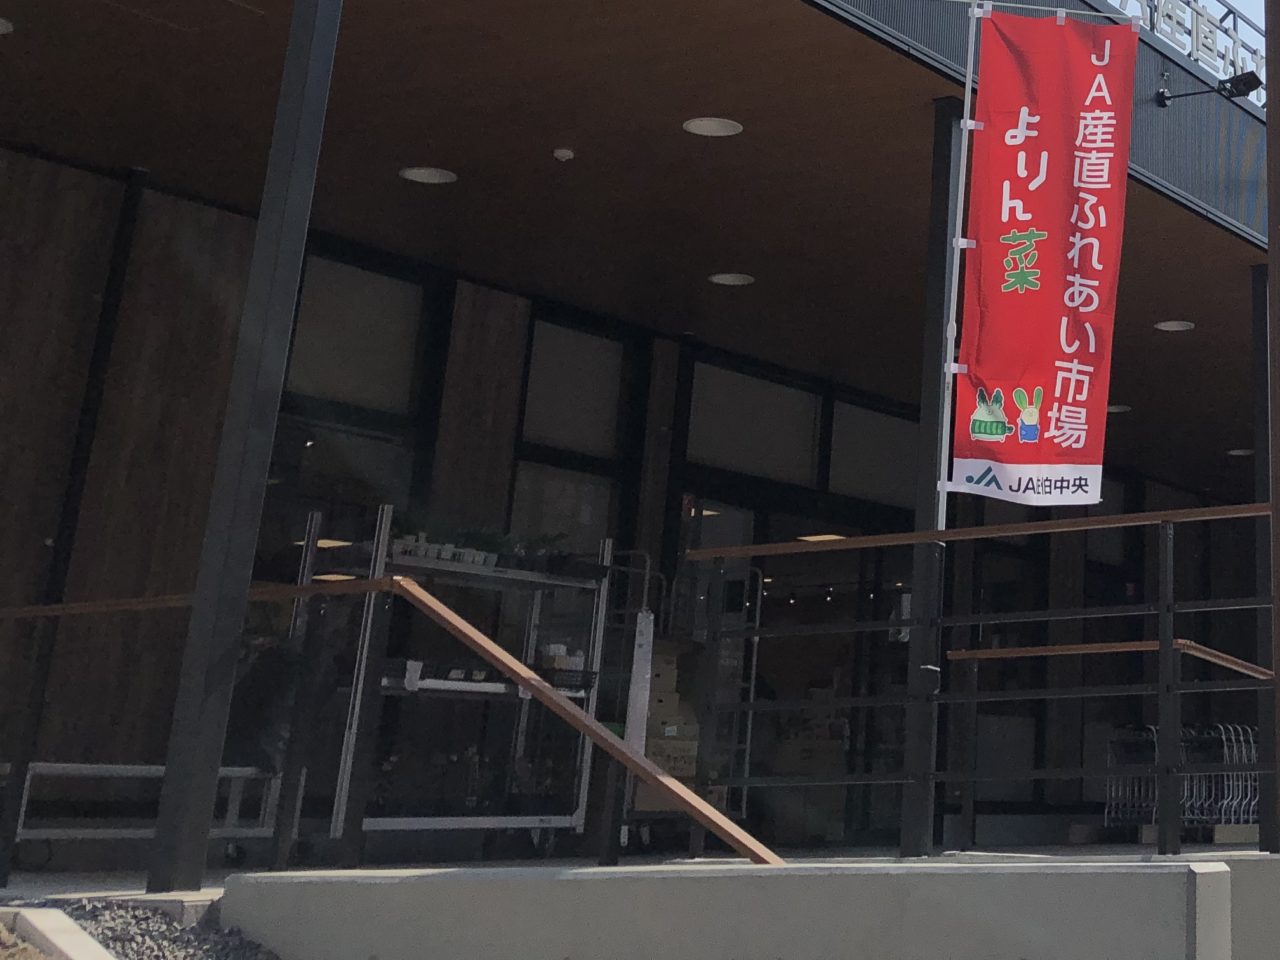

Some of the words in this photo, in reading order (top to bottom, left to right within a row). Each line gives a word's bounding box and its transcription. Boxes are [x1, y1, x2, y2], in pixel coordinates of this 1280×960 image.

[1000, 105, 1048, 294] よりん菜
[1043, 39, 1117, 450] JA産直ふれあい市場
